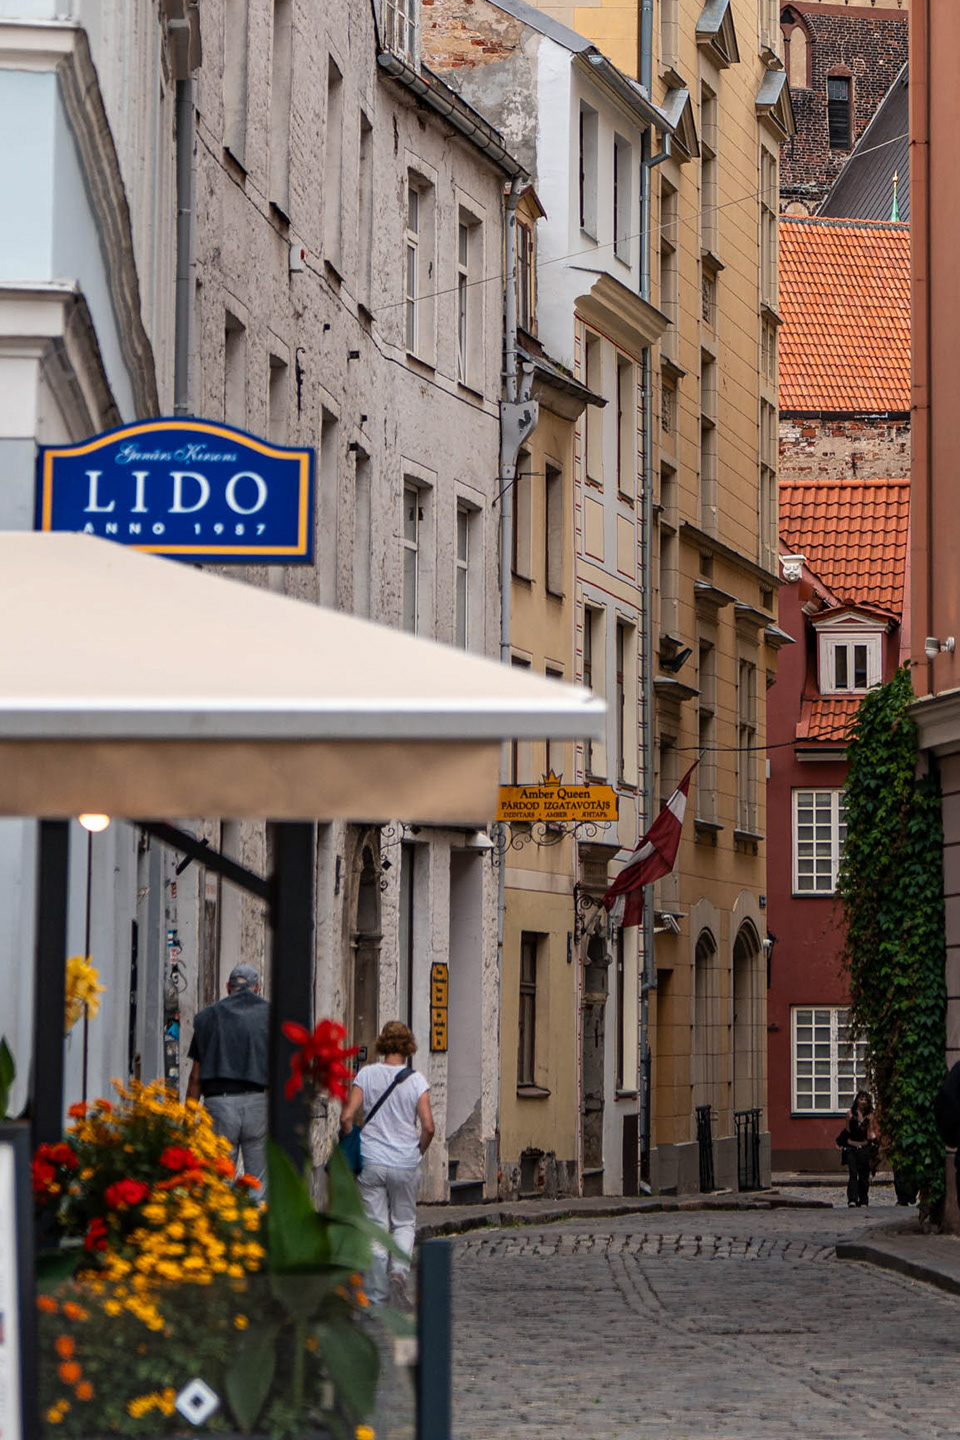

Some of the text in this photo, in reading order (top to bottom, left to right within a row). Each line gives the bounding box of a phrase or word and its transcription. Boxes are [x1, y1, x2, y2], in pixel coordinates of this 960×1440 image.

[83, 470, 268, 515] LIDO
[83, 521, 266, 536] ANNO 1987
[520, 788, 590, 800] Amber Queen
